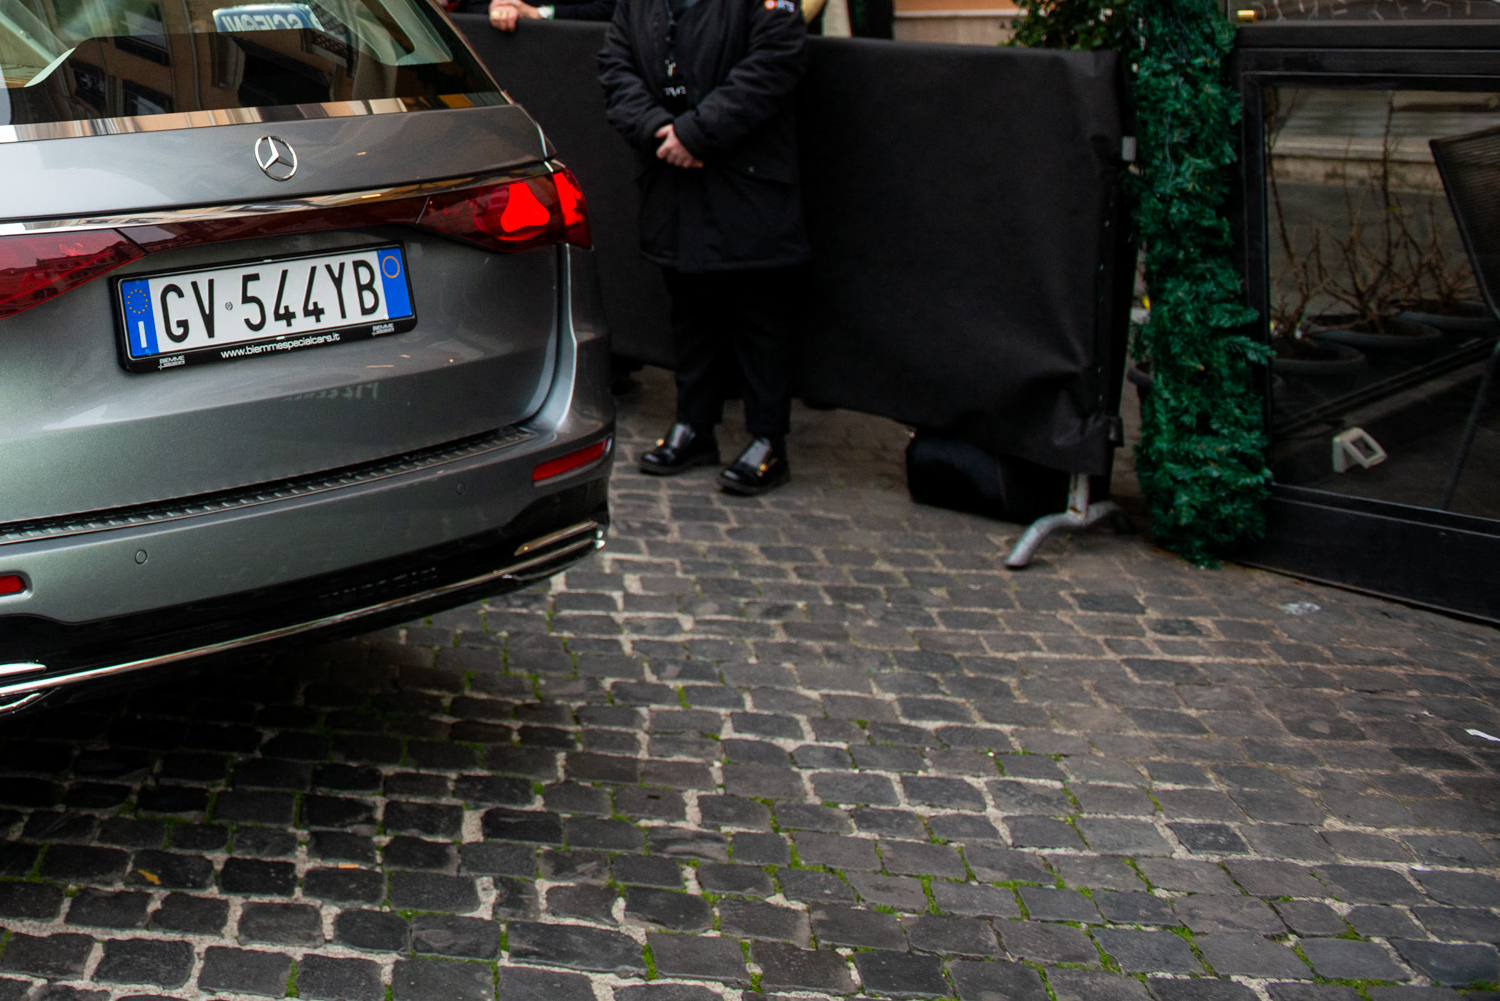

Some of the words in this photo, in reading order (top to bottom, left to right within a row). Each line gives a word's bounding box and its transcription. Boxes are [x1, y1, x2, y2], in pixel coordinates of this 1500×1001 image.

[160, 279, 215, 343] GV
[241, 259, 380, 332] 544YB
[137, 320, 148, 349] I
[220, 332, 340, 358] www.biemmespecialcars.it
